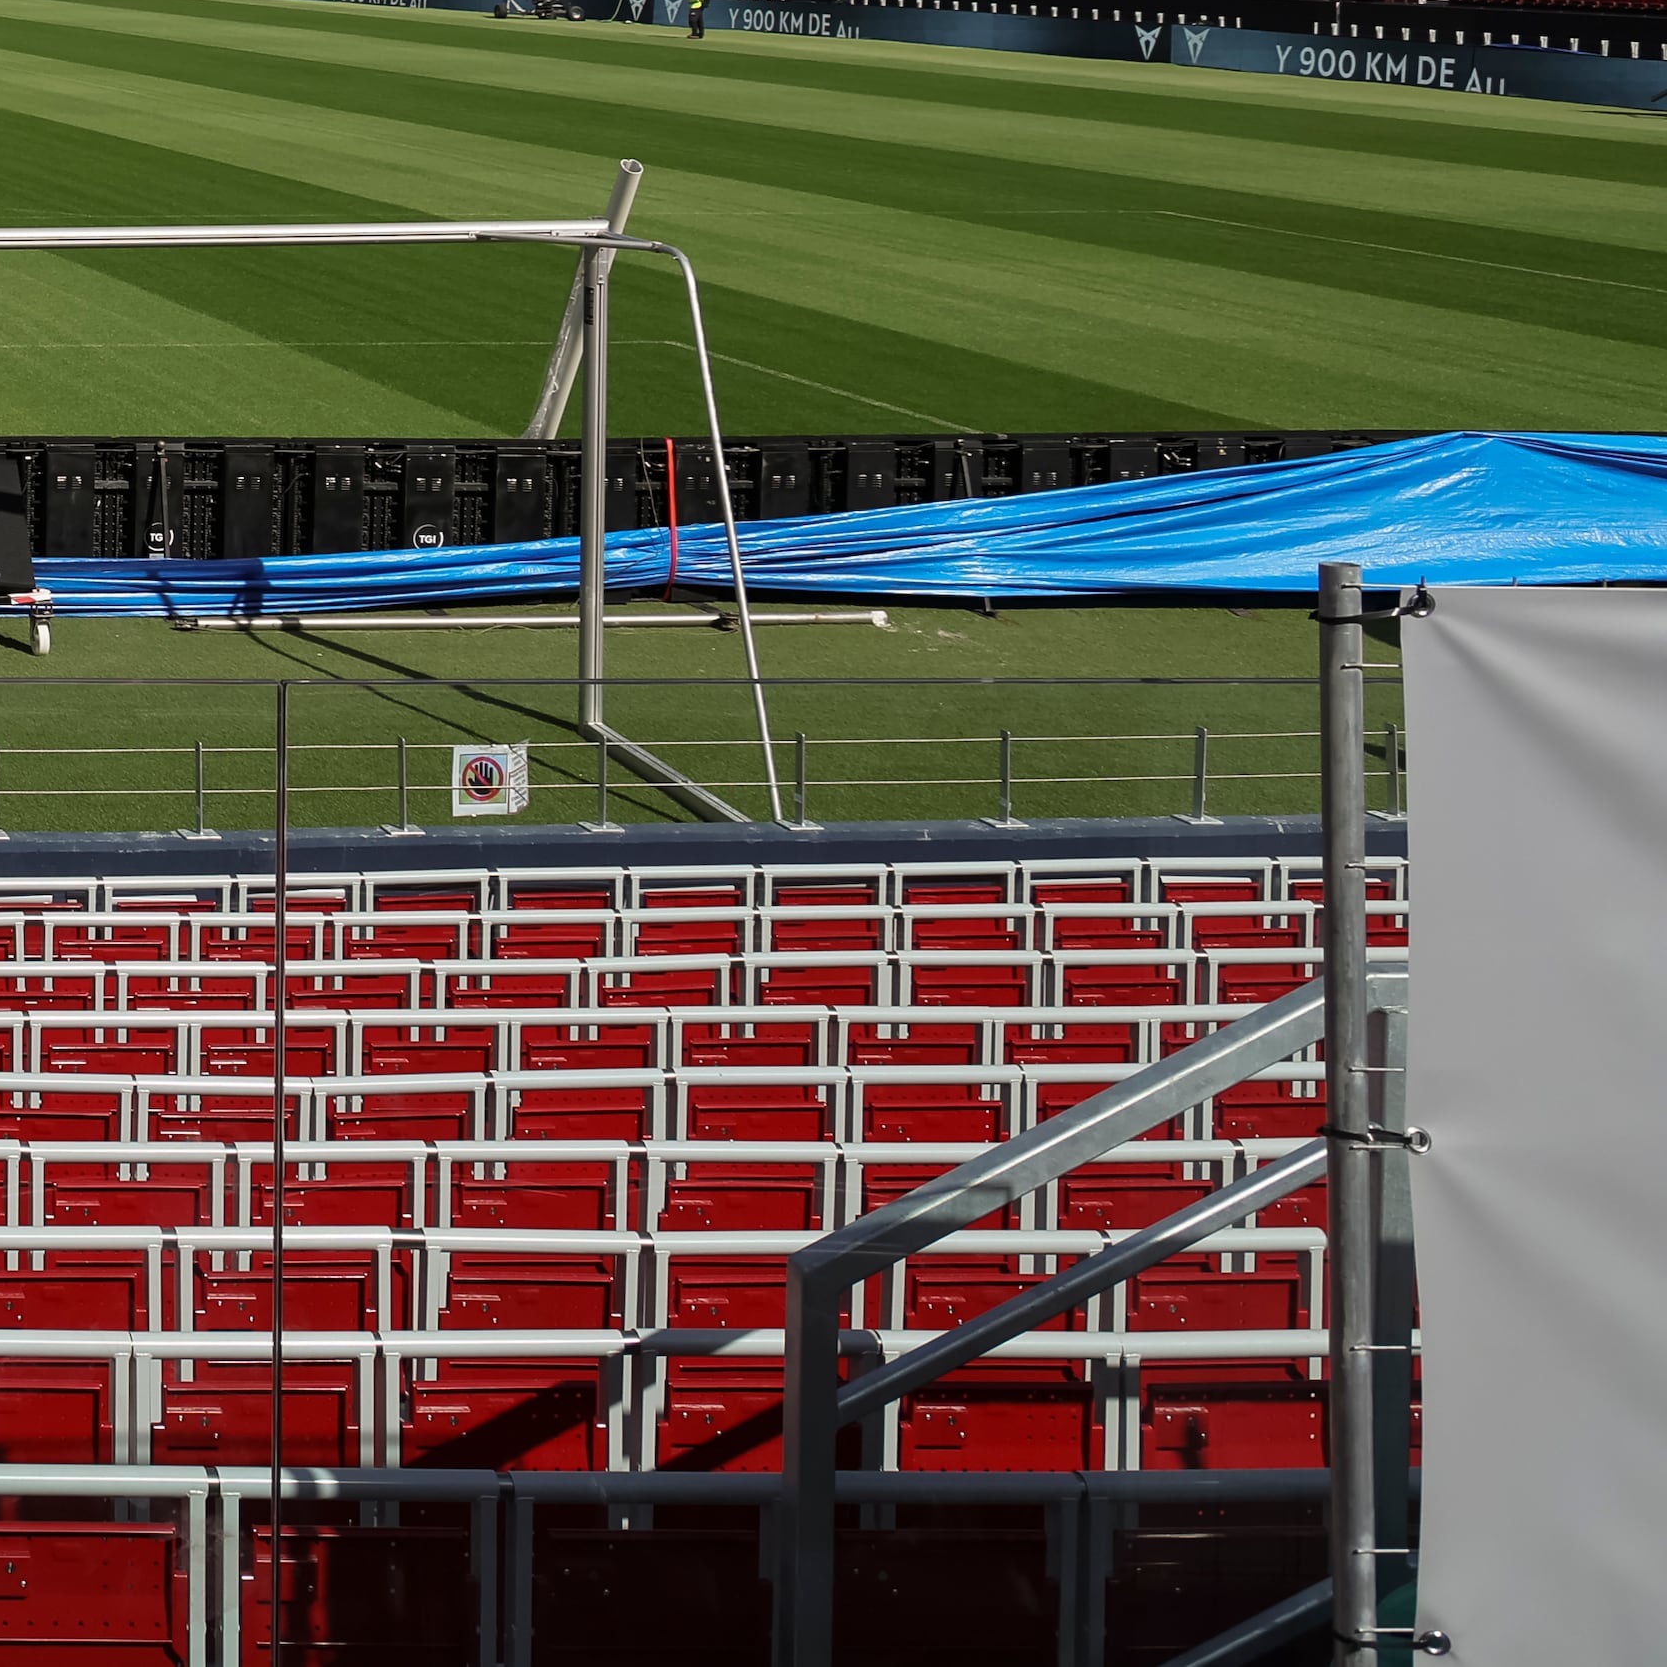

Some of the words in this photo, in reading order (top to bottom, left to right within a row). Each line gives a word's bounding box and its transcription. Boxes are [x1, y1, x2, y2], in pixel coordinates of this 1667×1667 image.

[729, 8, 739, 29] Y
[743, 9, 775, 32] 900
[779, 11, 804, 34] KM
[808, 13, 831, 36] DE
[1276, 45, 1293, 73] Y
[1299, 46, 1356, 79] 900
[1365, 51, 1407, 83] KM
[1417, 55, 1456, 88] DE
[418, 534, 436, 544] TGI
